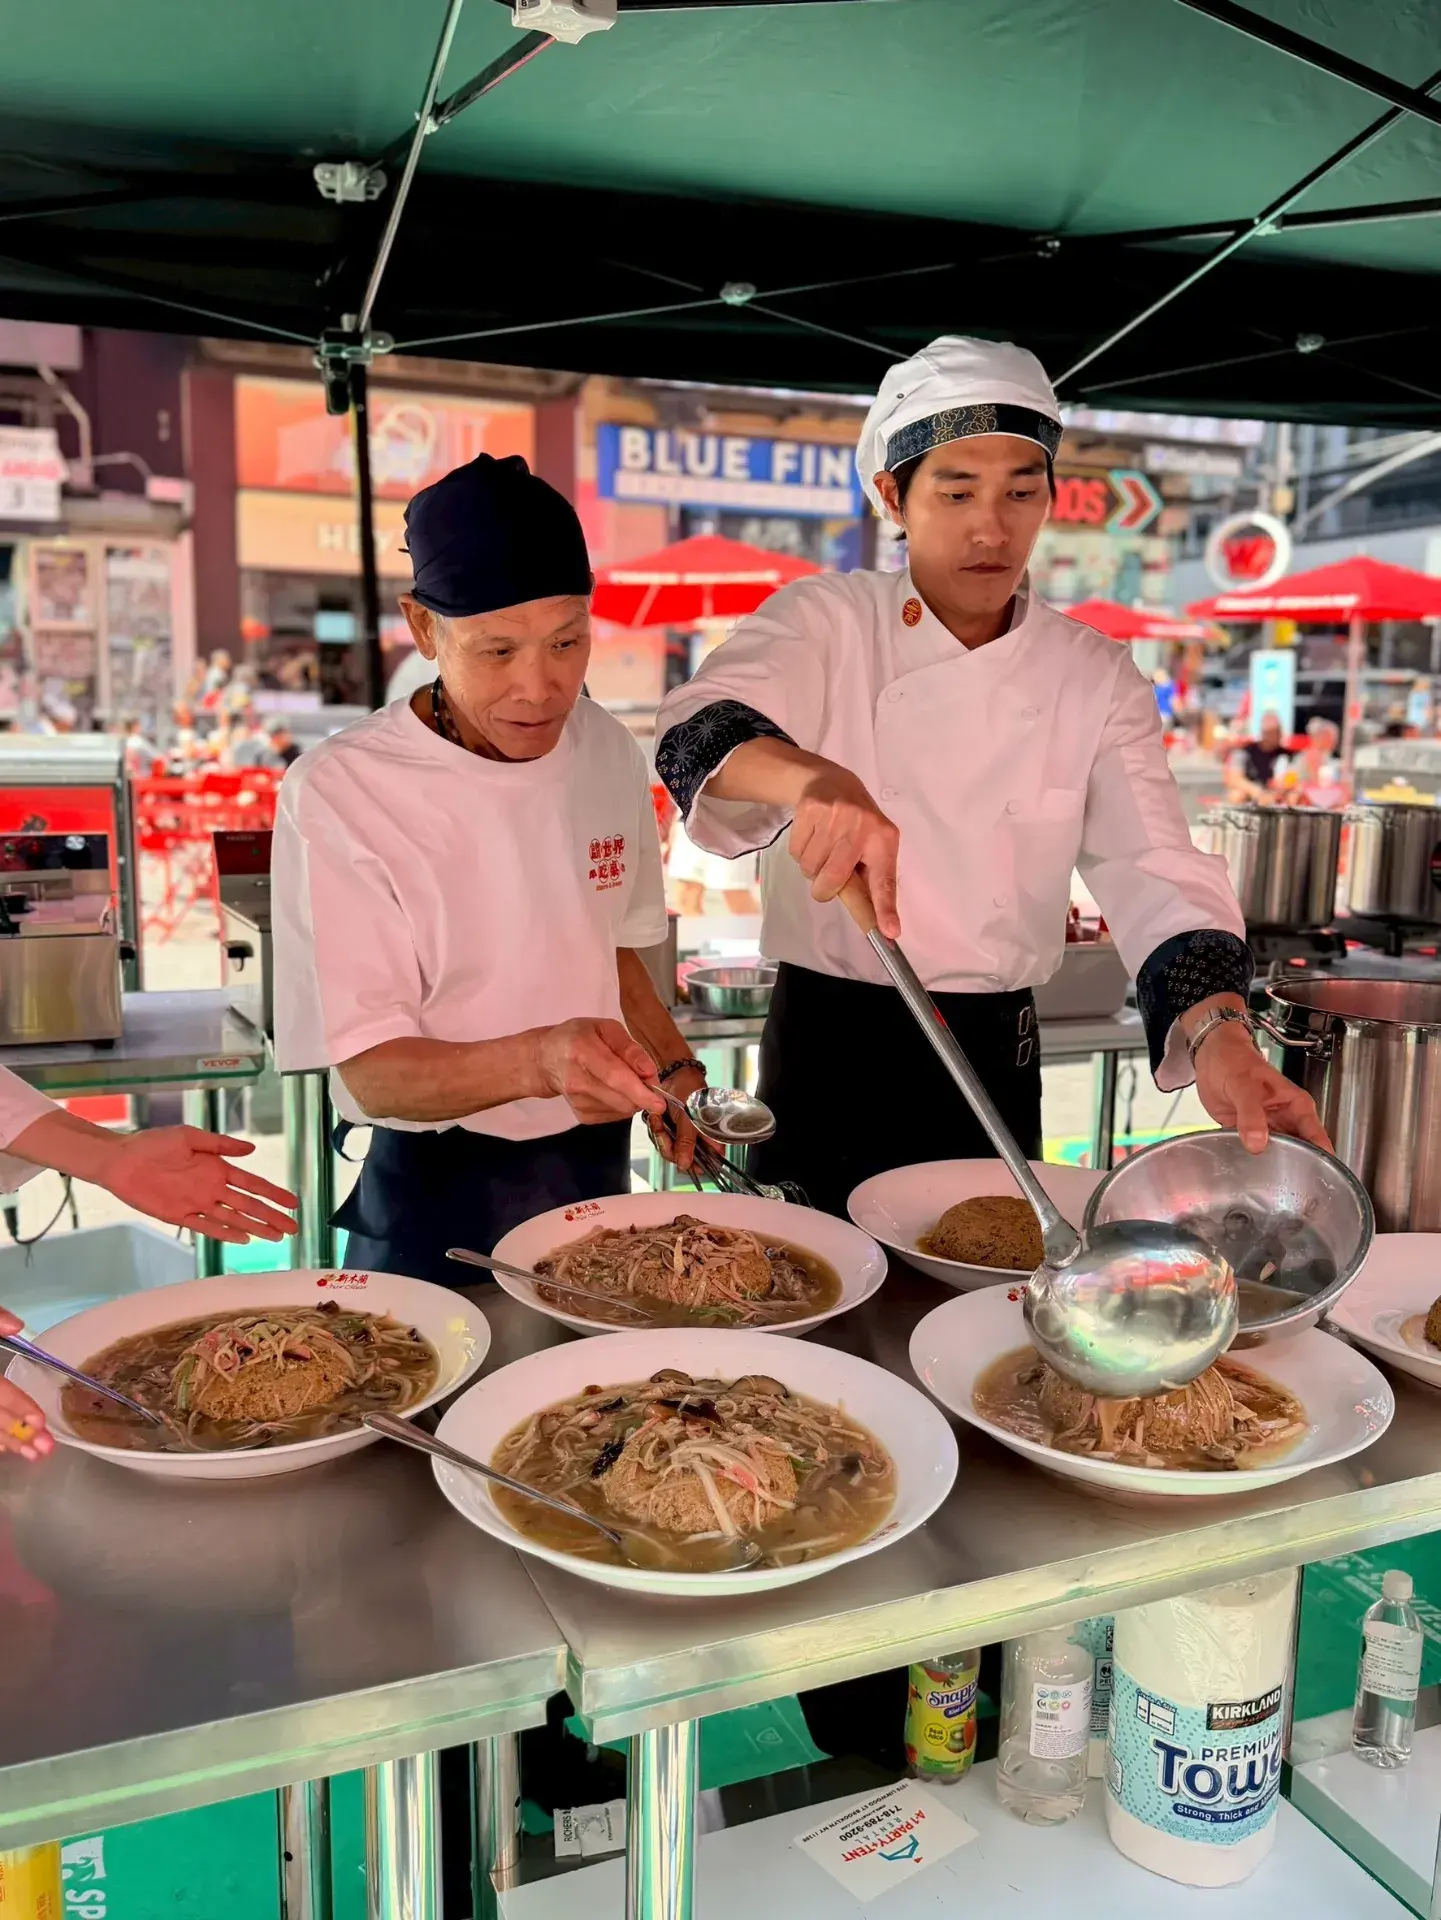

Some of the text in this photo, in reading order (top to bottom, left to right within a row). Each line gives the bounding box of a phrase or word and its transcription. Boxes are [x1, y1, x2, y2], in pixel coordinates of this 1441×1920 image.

[618, 427, 850, 487] BLUE FIN
[1212, 1690, 1281, 1720] KIRKLAND
[1202, 1729, 1280, 1762] PREMIUM
[829, 1809, 860, 1829] BROOKLYN
[839, 1804, 902, 1841] 718-789-9200
[1177, 1801, 1259, 1822] Strong, Thick and
[819, 1826, 829, 1834] NY
[854, 1817, 902, 1844] RENTAL
